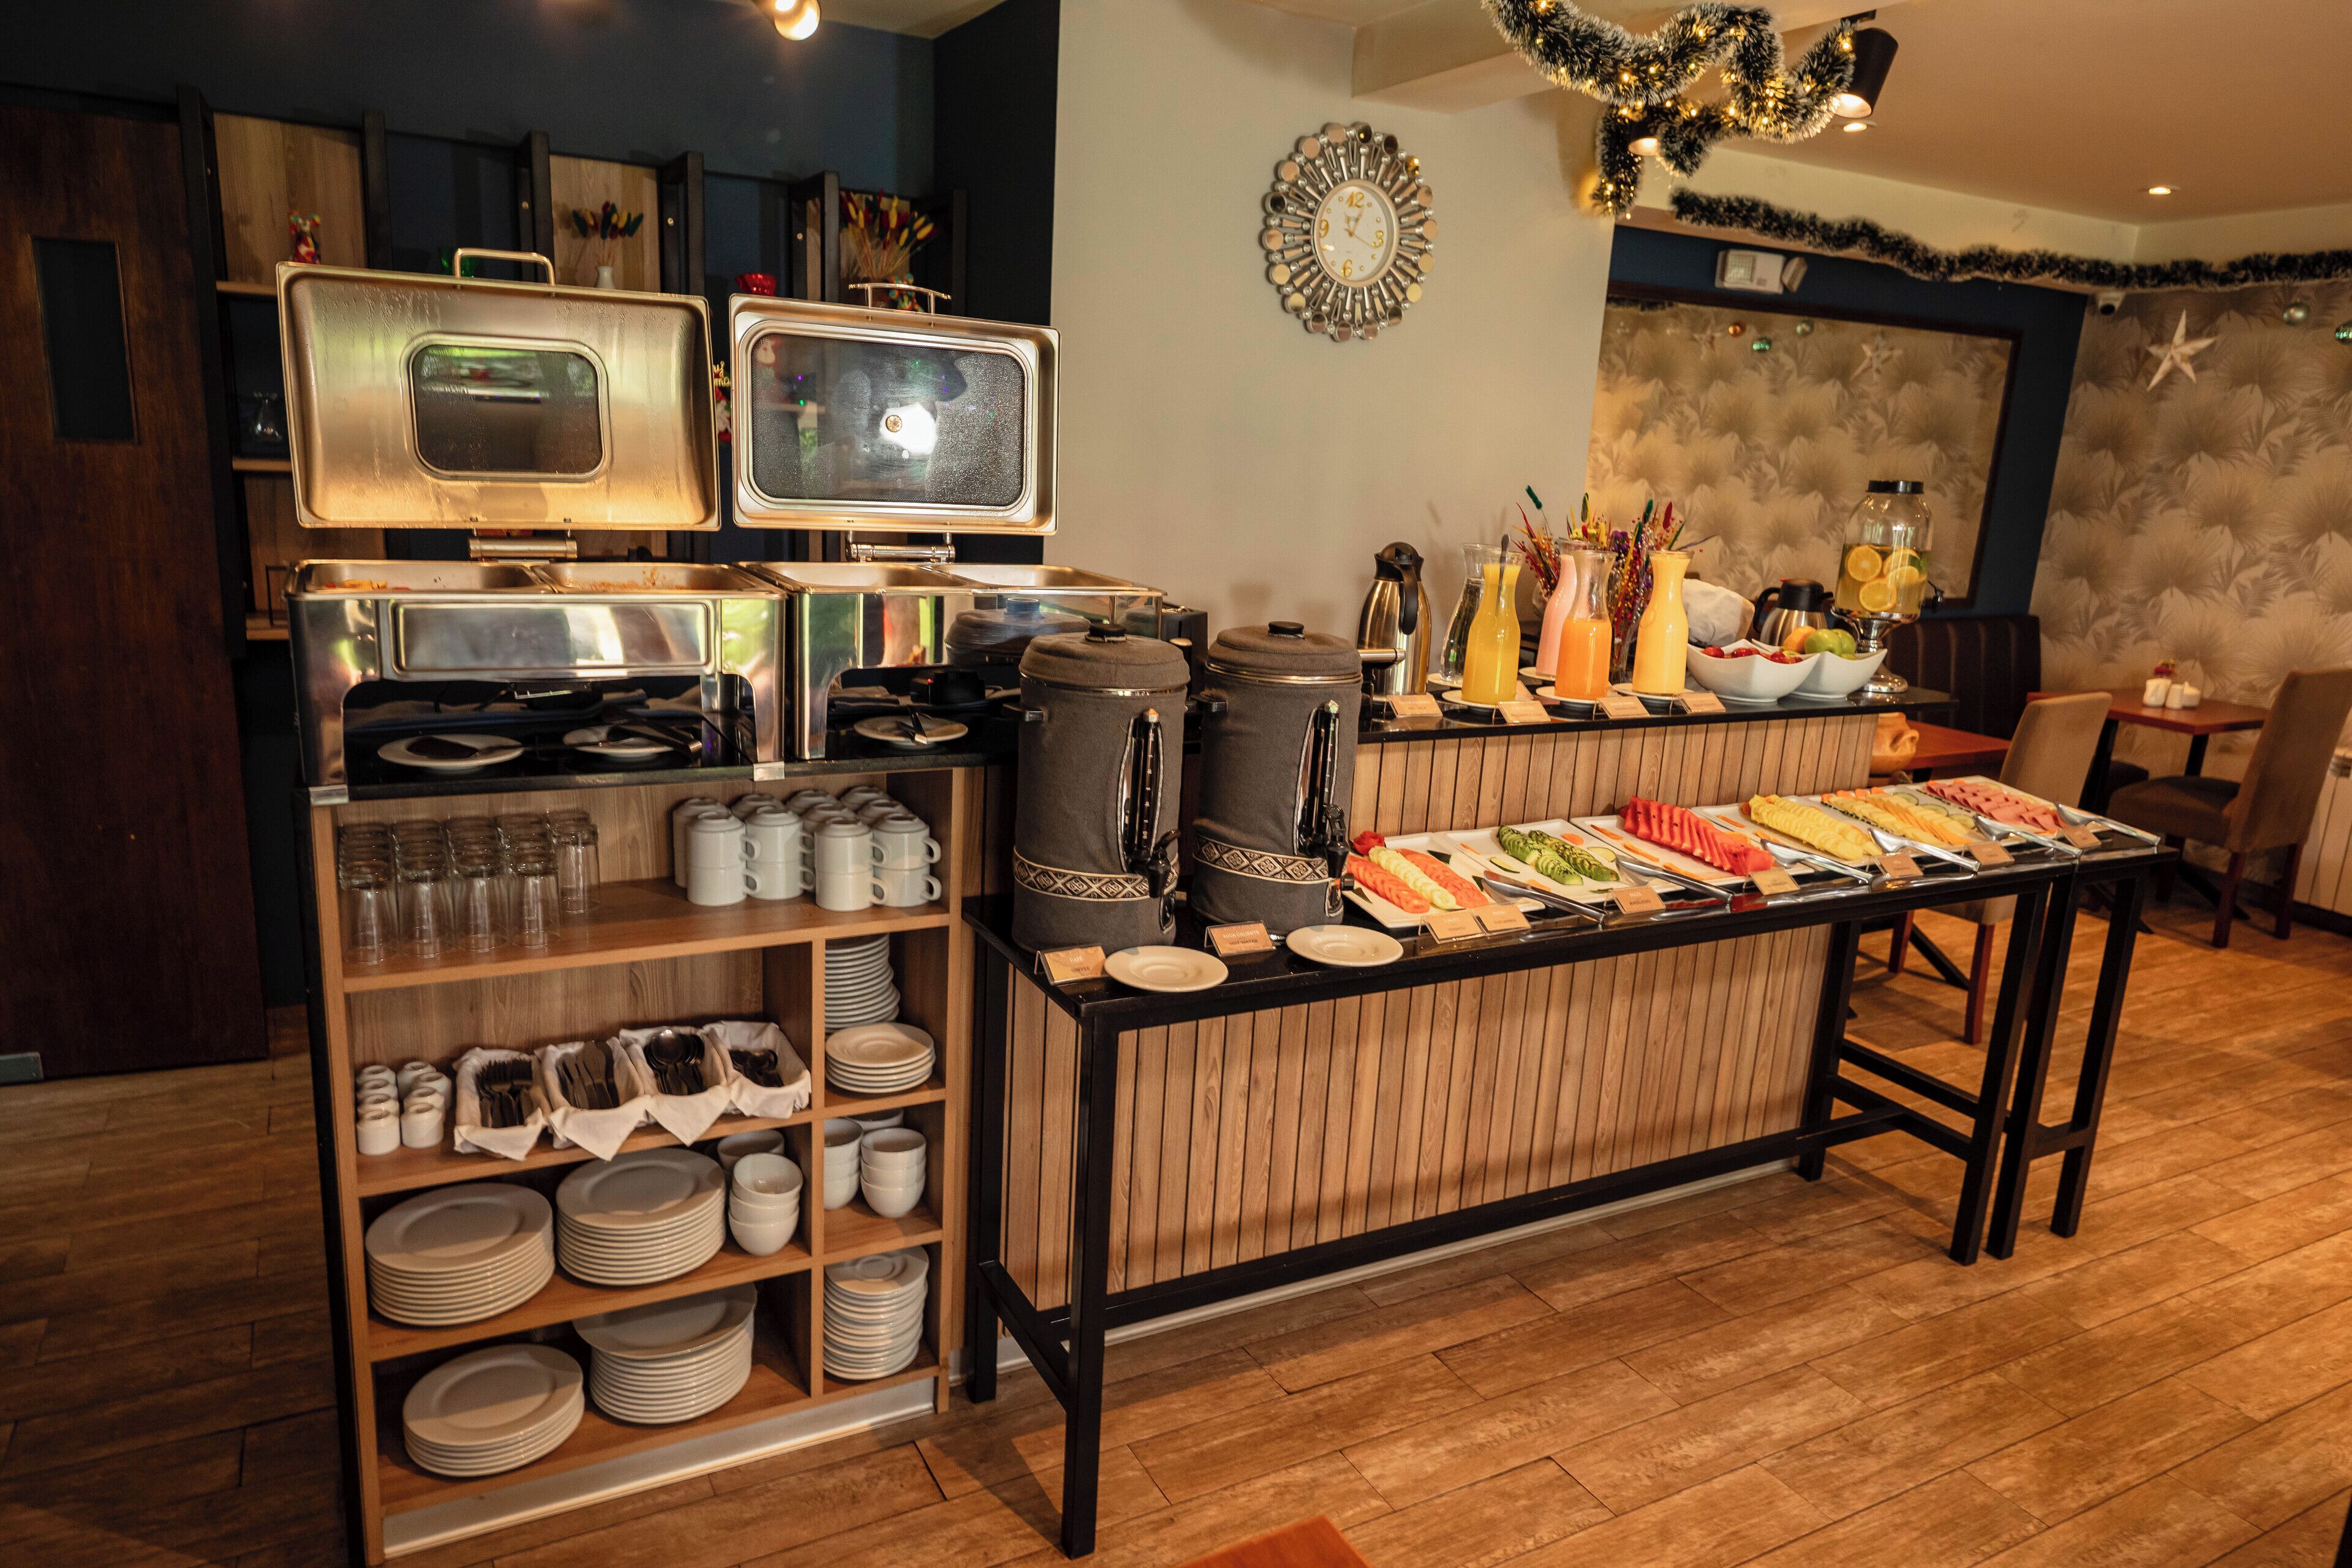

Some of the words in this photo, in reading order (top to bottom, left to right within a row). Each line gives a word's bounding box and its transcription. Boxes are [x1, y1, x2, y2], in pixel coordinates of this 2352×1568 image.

[1347, 191, 1364, 208] 12
[1319, 219, 1330, 238] 9
[1372, 230, 1384, 249] 3
[1341, 258, 1352, 277] 6
